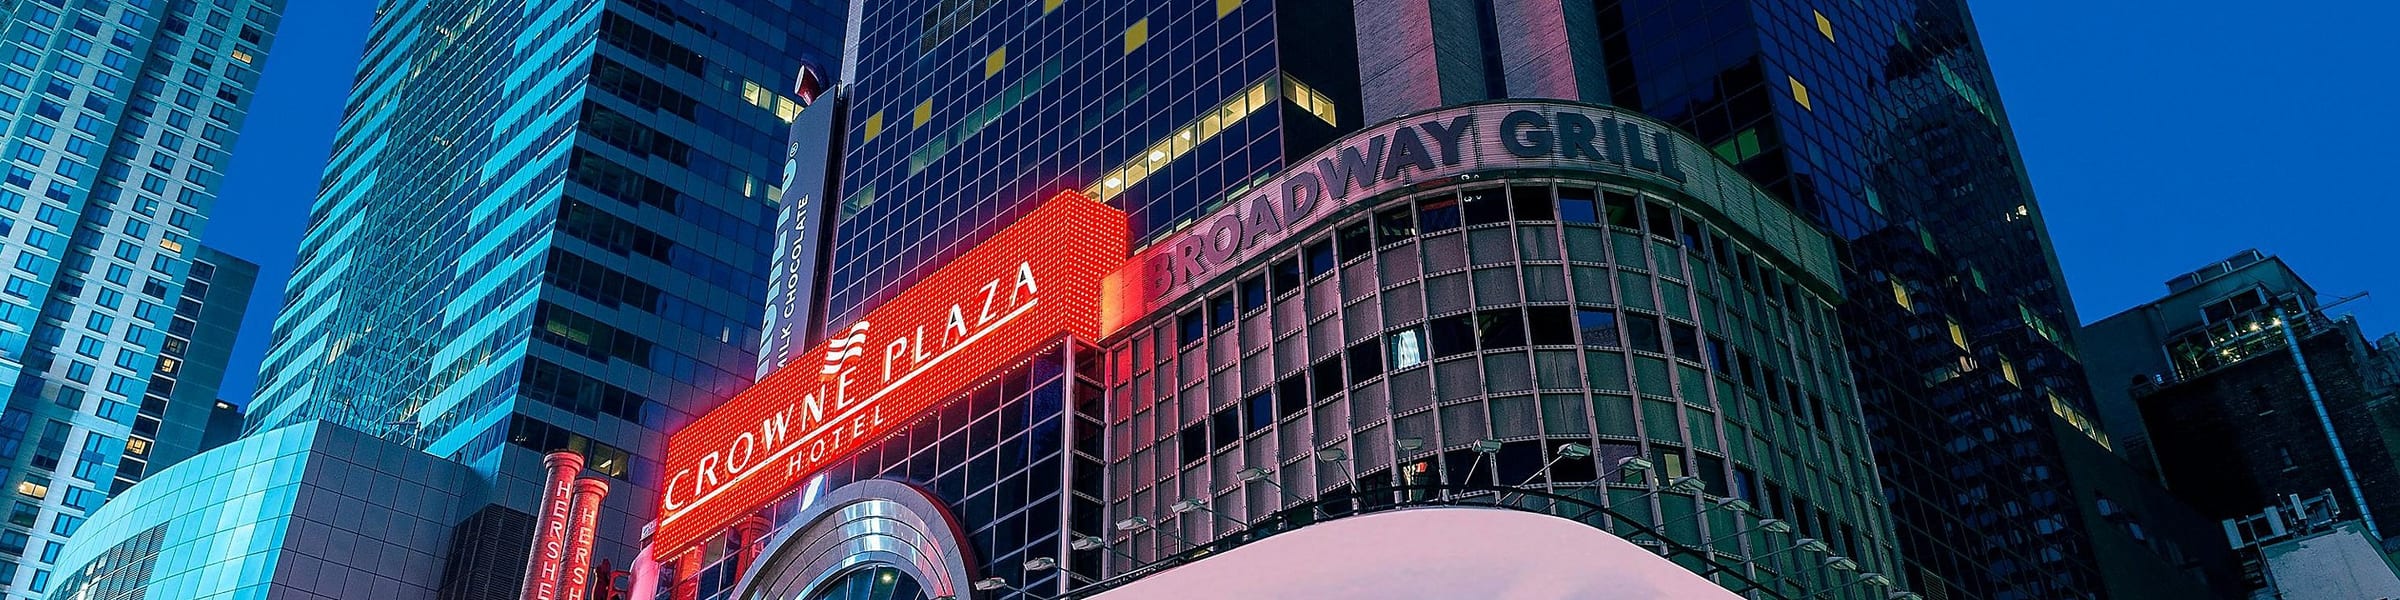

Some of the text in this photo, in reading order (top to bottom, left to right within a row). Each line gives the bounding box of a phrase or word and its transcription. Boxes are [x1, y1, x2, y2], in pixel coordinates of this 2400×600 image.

[784, 194, 809, 318] CHOCOLATE
[1147, 110, 1688, 302] BROADWAY GRILL
[665, 366, 857, 511] CROWNE
[884, 261, 1038, 382] PLAZA
[788, 405, 884, 477] HOTEL
[537, 480, 571, 600] HERSHE
[568, 507, 595, 600] HERSH
